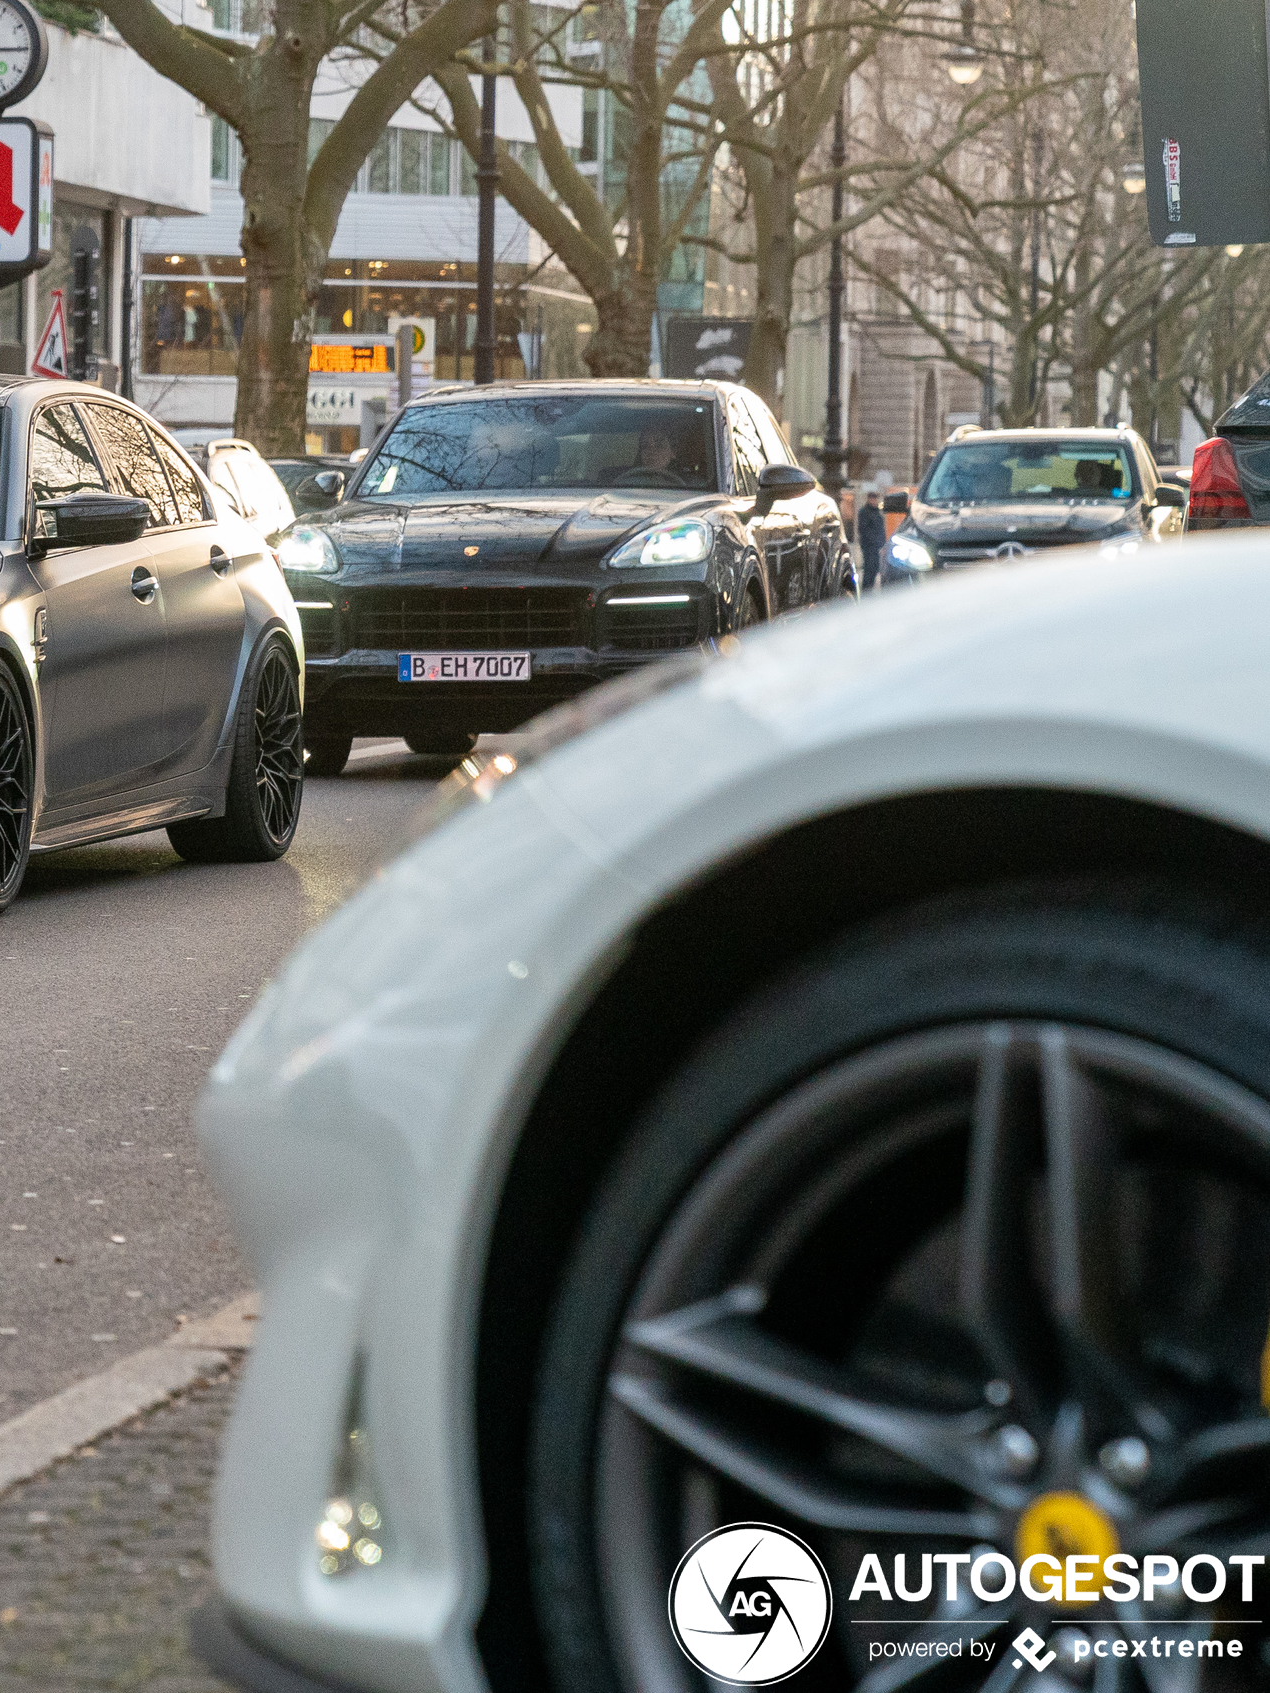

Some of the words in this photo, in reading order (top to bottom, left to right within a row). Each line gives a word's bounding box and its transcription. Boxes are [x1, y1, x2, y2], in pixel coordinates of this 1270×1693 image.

[413, 657, 425, 677] B
[441, 657, 468, 677] EH
[473, 657, 526, 677] 7007
